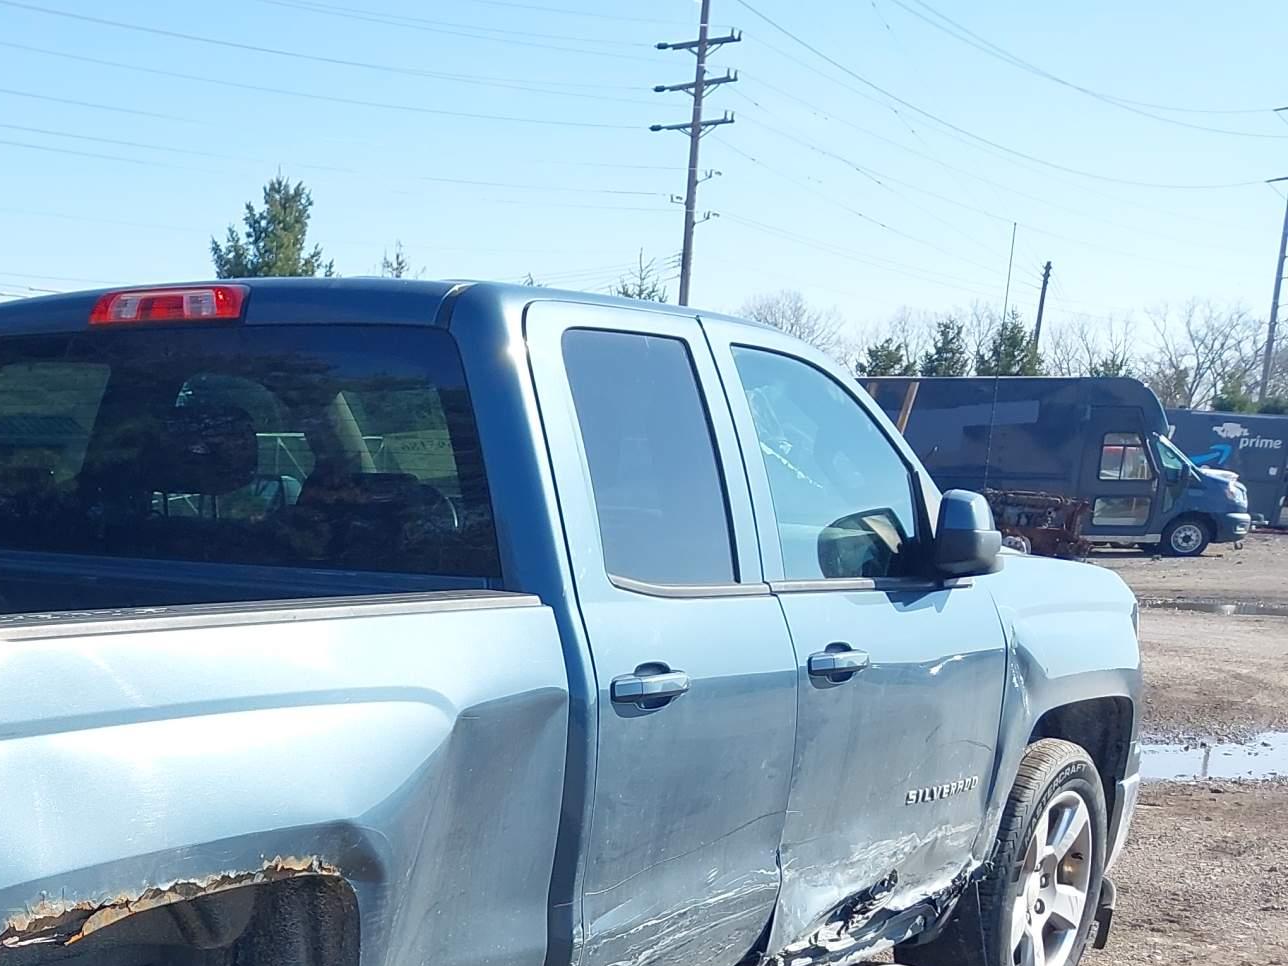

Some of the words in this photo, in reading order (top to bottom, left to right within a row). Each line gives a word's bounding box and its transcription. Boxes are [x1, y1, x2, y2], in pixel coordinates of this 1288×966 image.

[1239, 435, 1282, 449] prime
[905, 775, 979, 805] SILVERADO
[1023, 763, 1086, 850] MASTERCRAFT
